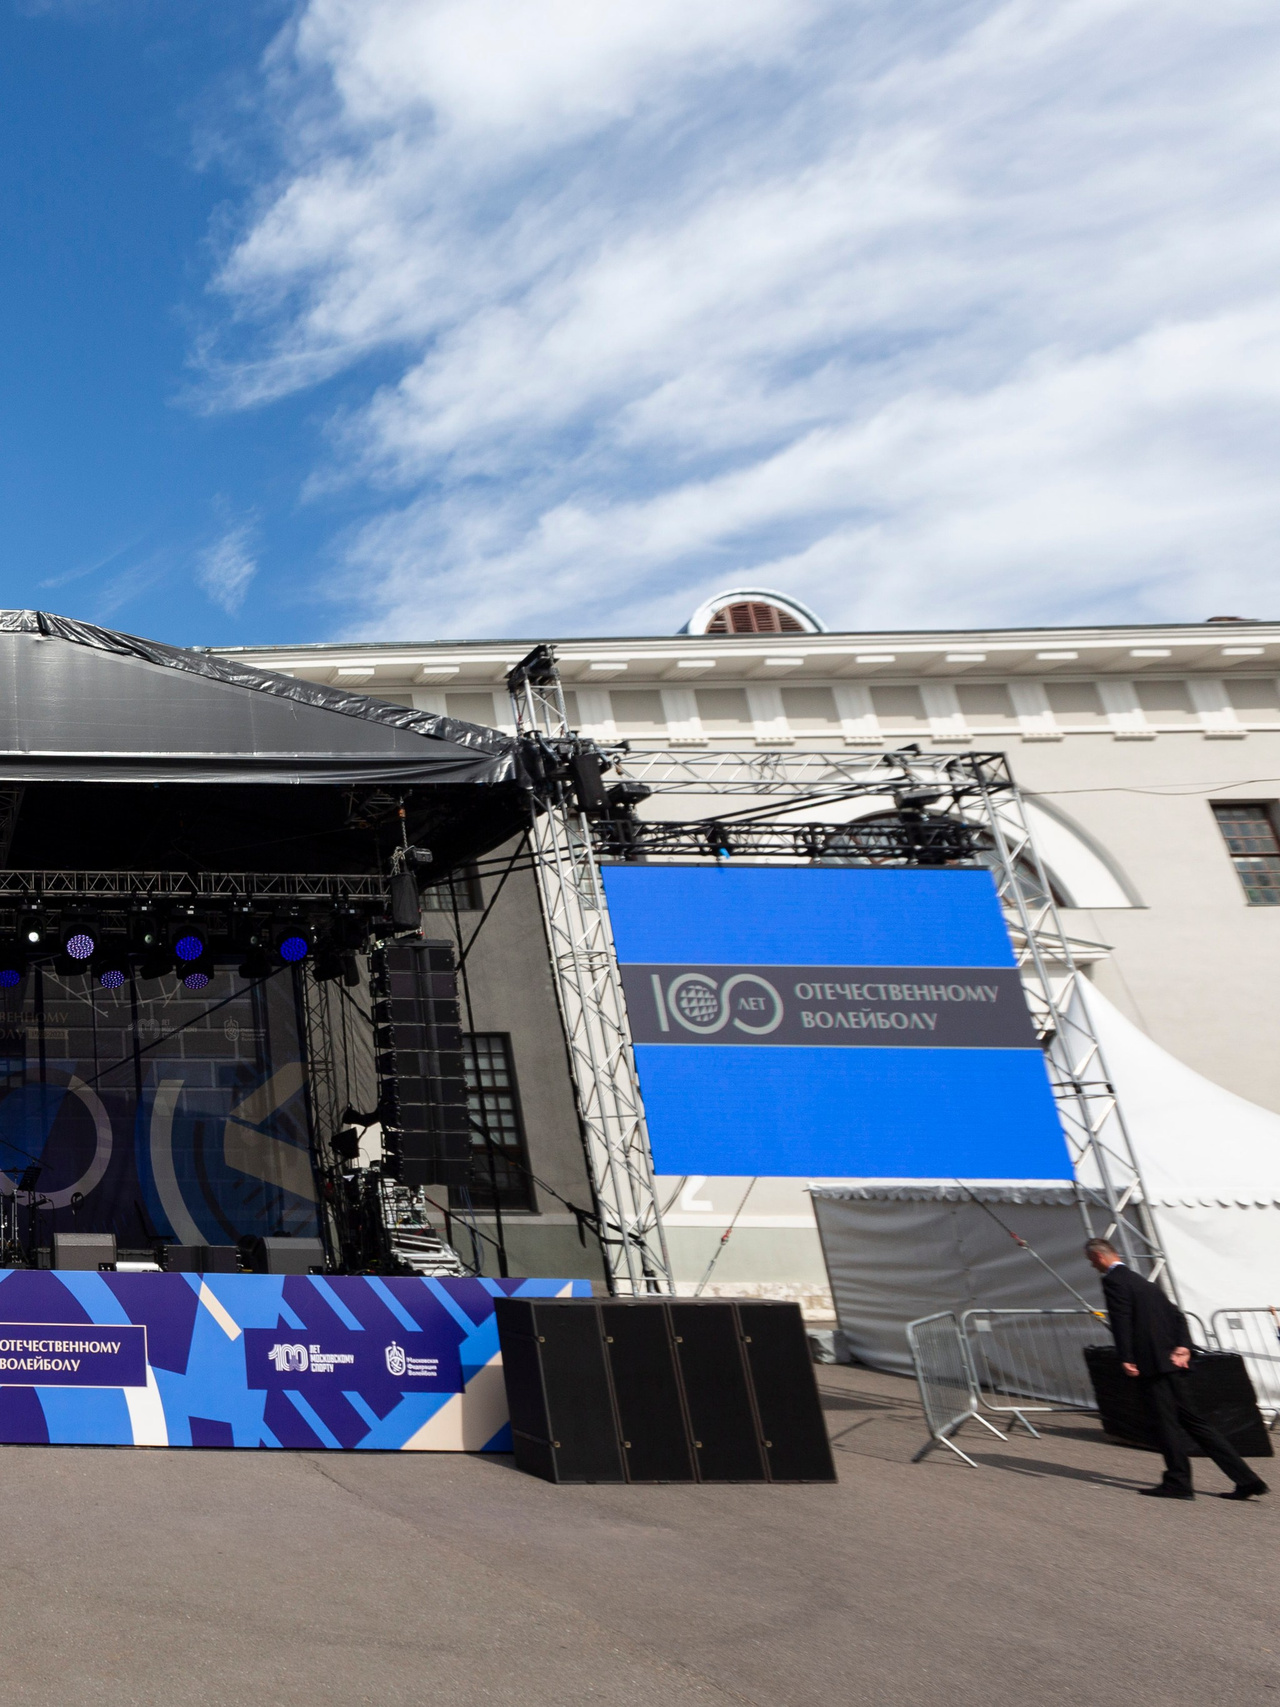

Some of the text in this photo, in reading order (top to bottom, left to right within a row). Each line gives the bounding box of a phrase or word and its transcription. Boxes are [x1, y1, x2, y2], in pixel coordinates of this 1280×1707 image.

[738, 997, 766, 1011] ЛЕТ
[794, 982, 999, 1004] ОТЕЧЕСТВЕННОМУ
[801, 1008, 938, 1031] ВОЛЕЙБОЛУ
[268, 1343, 309, 1372] 100
